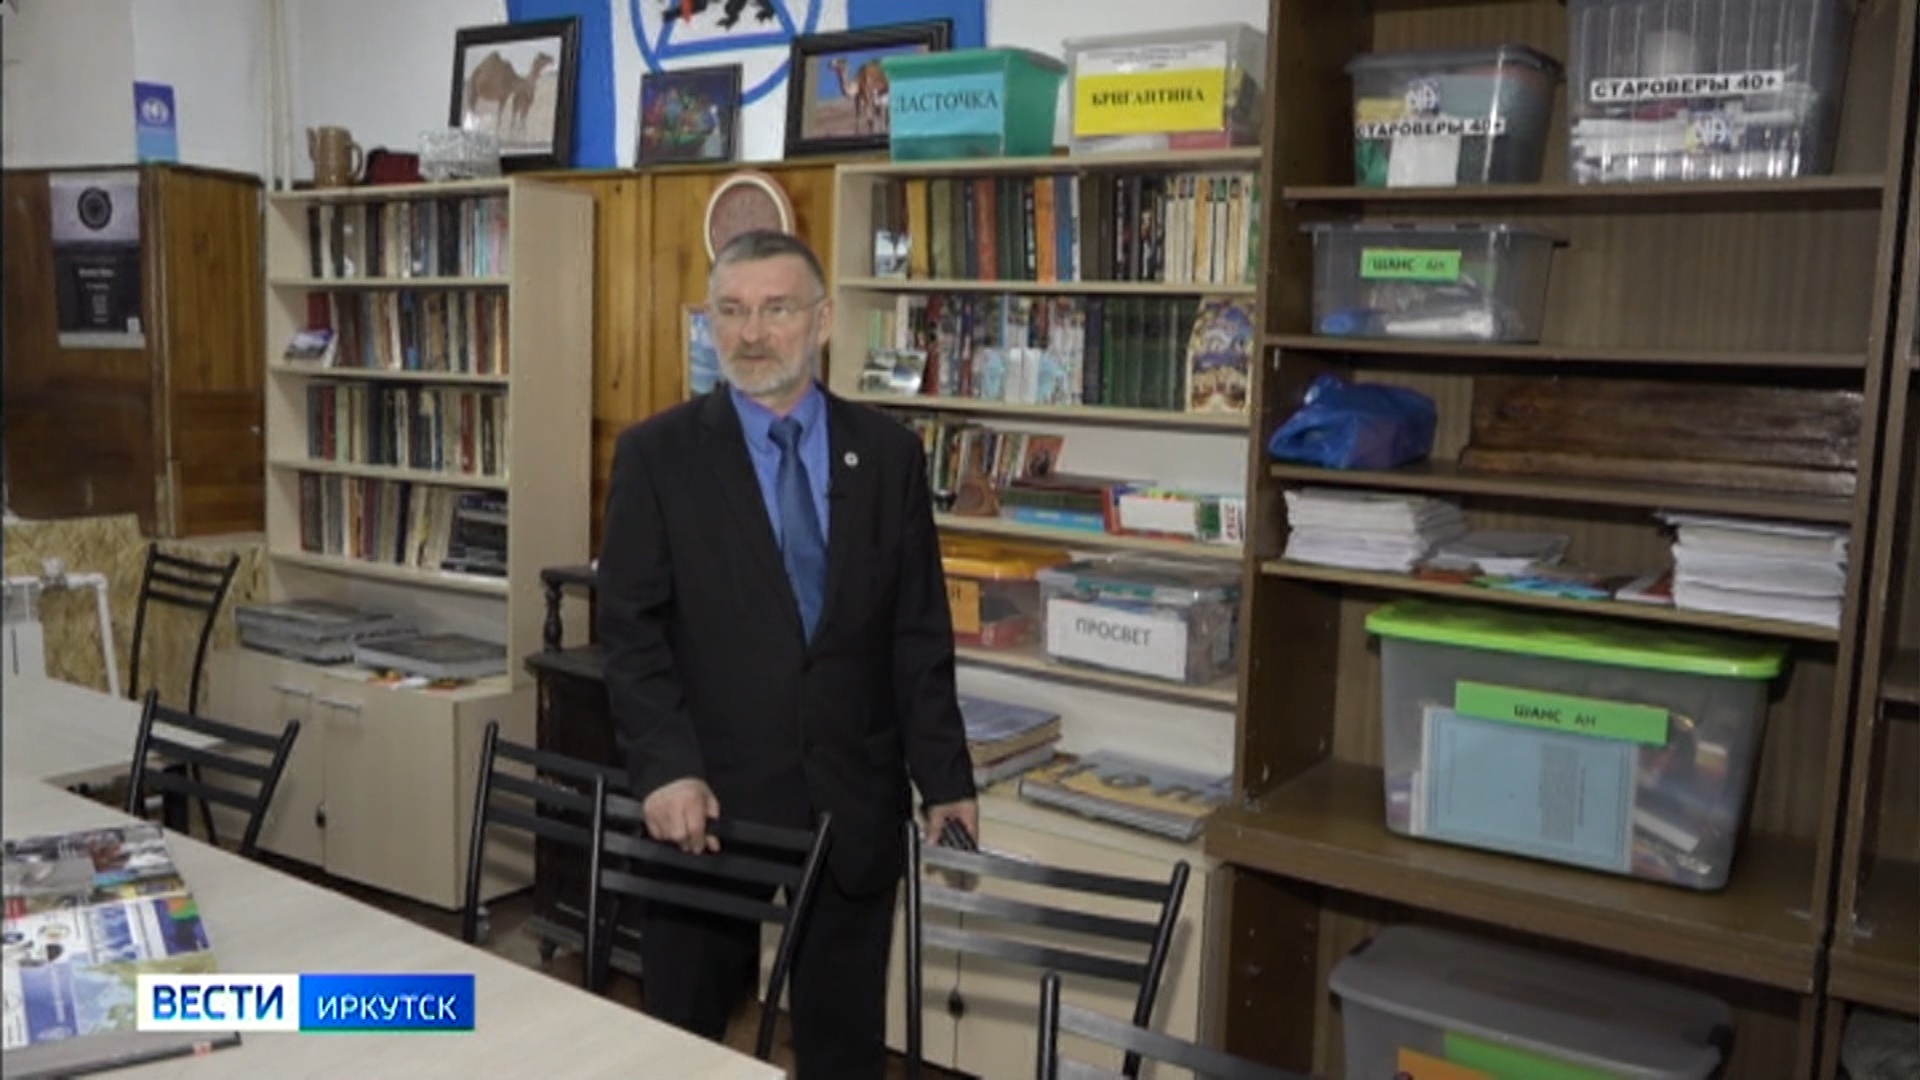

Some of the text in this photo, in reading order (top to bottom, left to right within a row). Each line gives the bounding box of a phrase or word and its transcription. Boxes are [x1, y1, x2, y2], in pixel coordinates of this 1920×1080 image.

[1091, 87, 1205, 108] БРИГАНТИНА
[1594, 74, 1777, 98] СТАРОВЕРЫ 40+
[893, 89, 999, 112] ЛАСТОЧКА
[1076, 618, 1153, 647] ПРОСВЕТ
